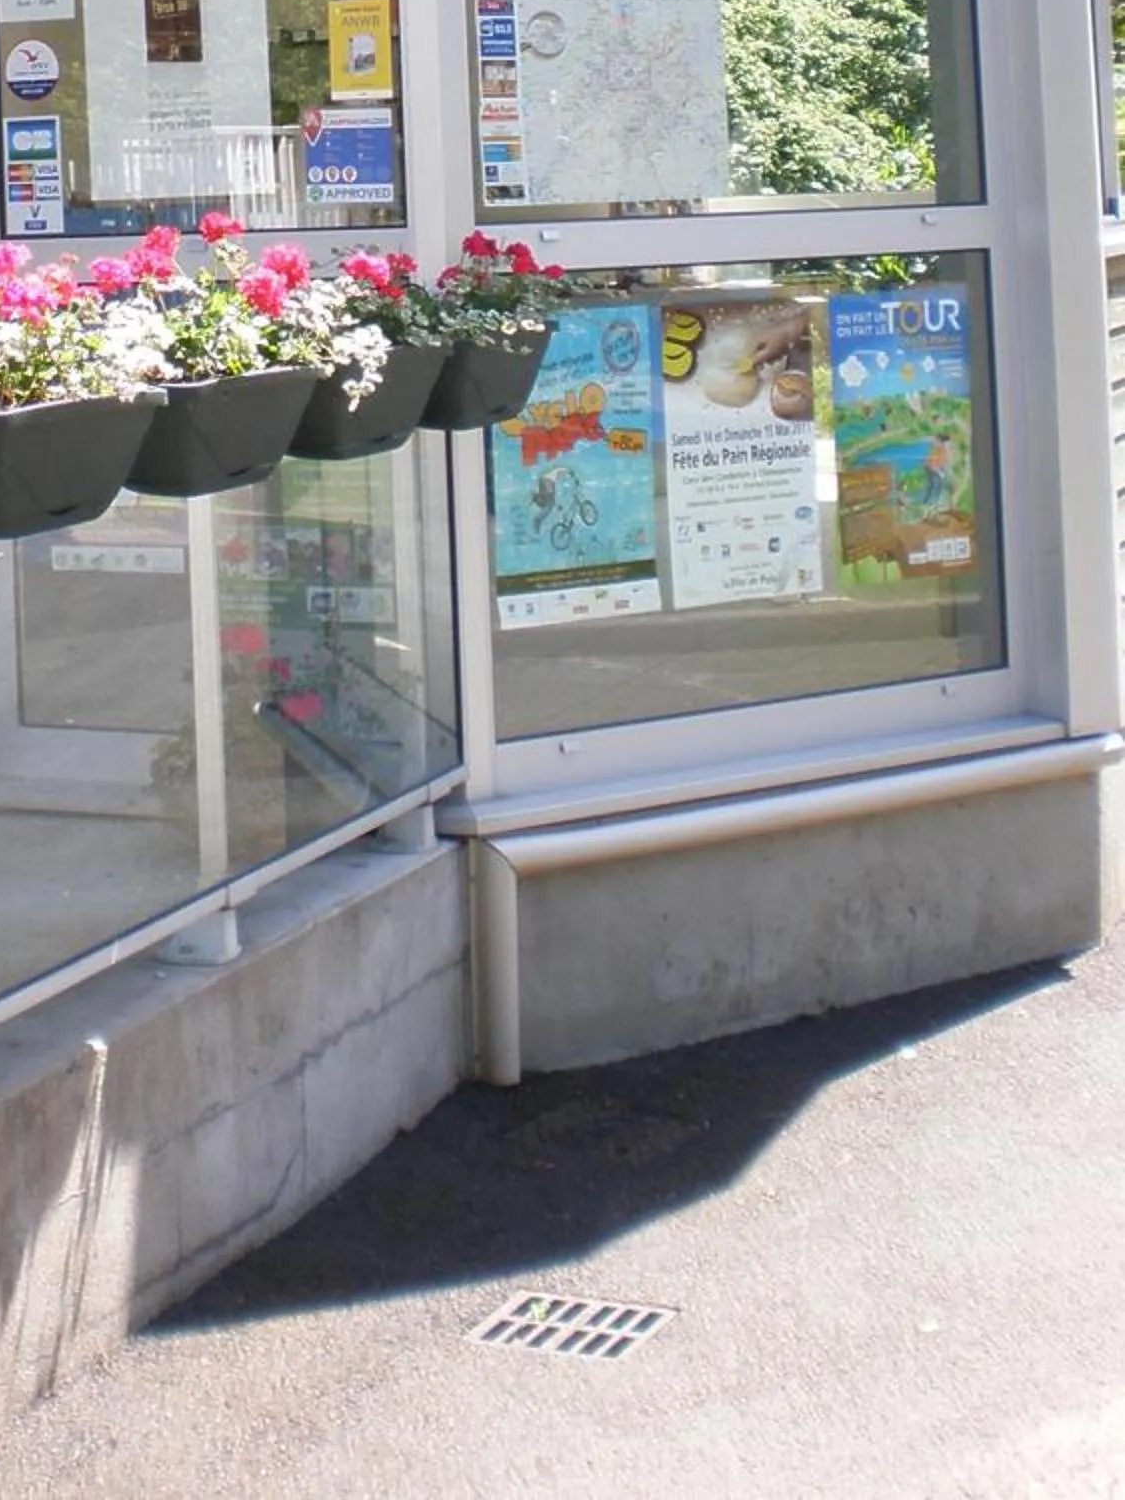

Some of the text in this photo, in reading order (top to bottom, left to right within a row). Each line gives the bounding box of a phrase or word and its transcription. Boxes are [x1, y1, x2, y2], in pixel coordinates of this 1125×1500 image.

[326, 184, 392, 199] APPROVED
[853, 312, 872, 324] FAIT
[880, 299, 962, 335] TOUR
[836, 326, 851, 338] ON
[854, 325, 873, 336] FAIT
[672, 432, 701, 446] Samedi
[725, 427, 762, 442] Dimanche
[775, 423, 789, 436] Mai
[673, 440, 812, 470] Fête du Pain Régionale
